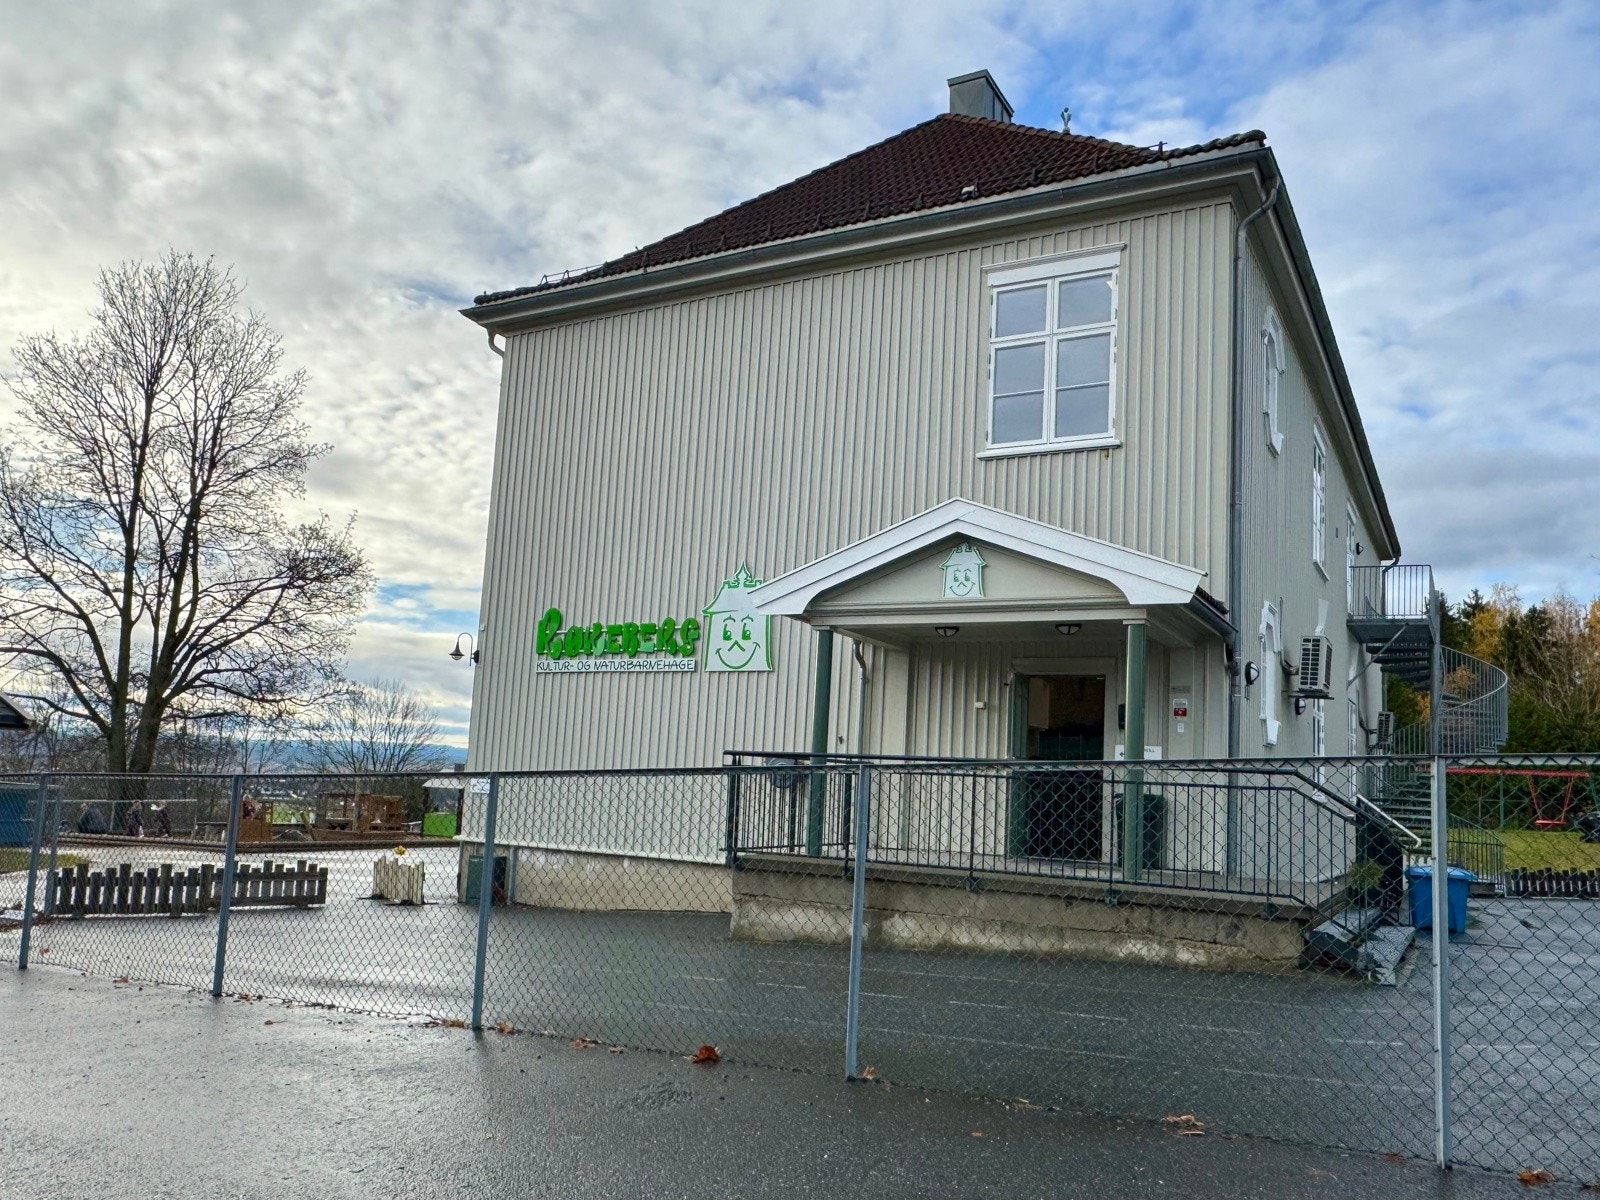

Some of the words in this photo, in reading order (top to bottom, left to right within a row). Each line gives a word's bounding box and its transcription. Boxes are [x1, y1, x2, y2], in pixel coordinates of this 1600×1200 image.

[536, 661, 574, 671] KULTUR-
[577, 660, 590, 671] OG
[594, 659, 694, 671] NATURBARNEHAGE
